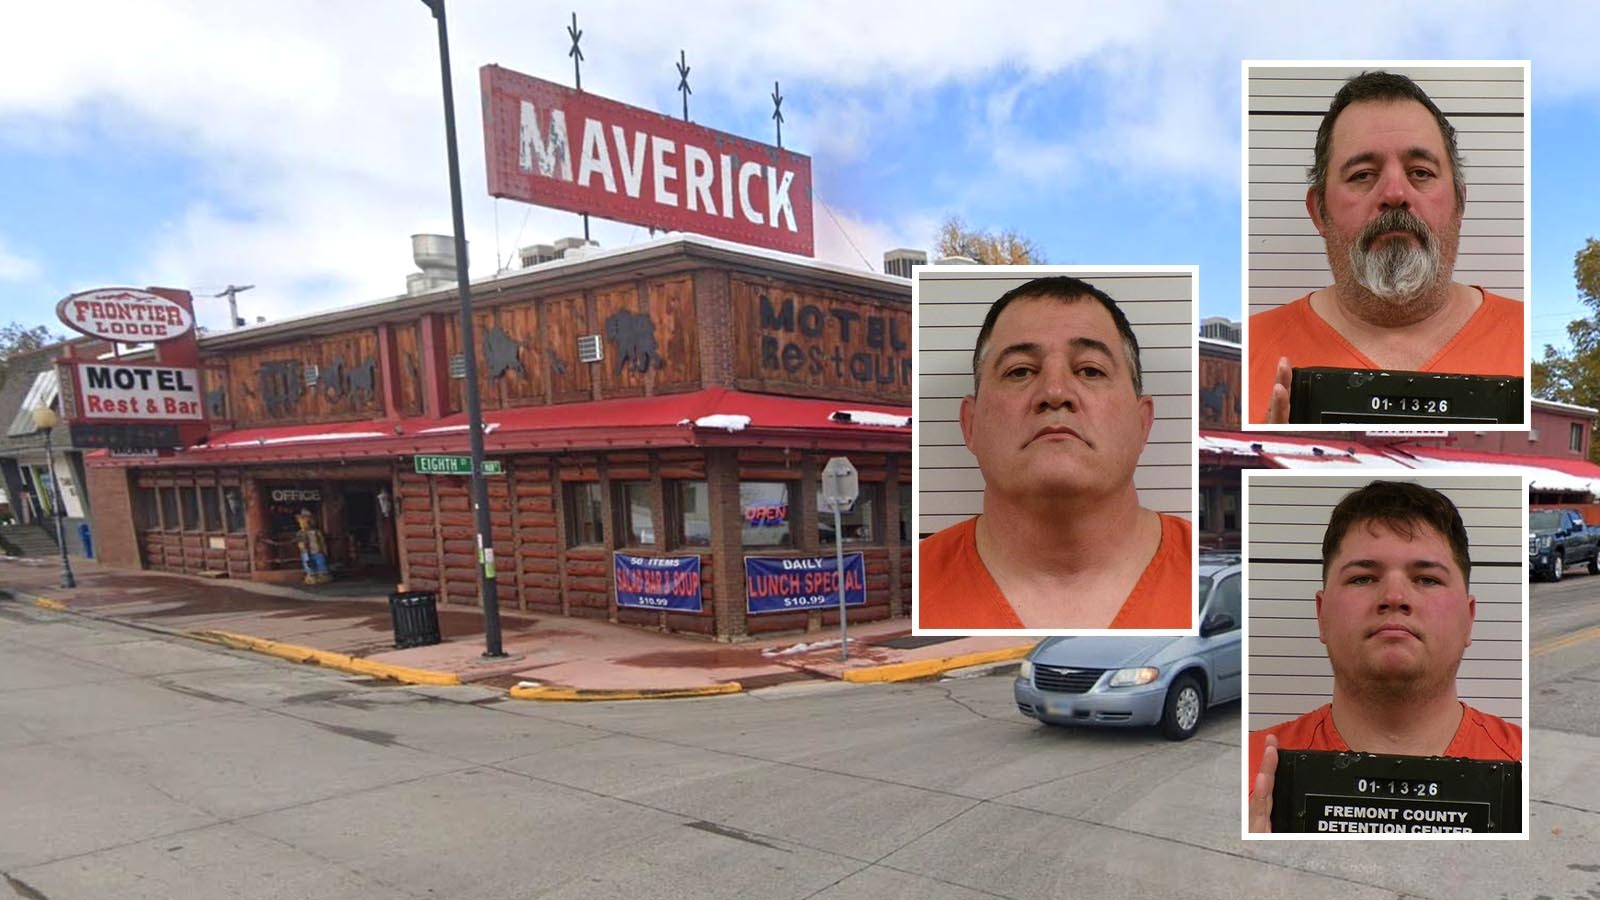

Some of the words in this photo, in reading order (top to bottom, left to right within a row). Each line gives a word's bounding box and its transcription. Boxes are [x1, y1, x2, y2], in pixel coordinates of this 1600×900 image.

[519, 100, 798, 233] MAVERICK
[73, 300, 184, 326] FRONTIER
[95, 321, 168, 336] LODGE
[759, 294, 908, 351] MOTEL
[86, 366, 193, 392] MOTEL
[88, 394, 139, 414] Rest
[146, 397, 158, 413] &
[164, 397, 199, 414] Bar
[420, 457, 458, 471] EIGHTH
[272, 489, 321, 501] OFFICE
[744, 505, 788, 521] OPEN
[648, 559, 680, 567] ITEMS
[782, 558, 823, 570] DAILY
[748, 573, 800, 597] LUNCH
[805, 568, 862, 594] SPECAL
[638, 597, 668, 606] $10.99
[783, 595, 825, 607] $10.99
[1324, 805, 1399, 820] FREMONT
[1402, 809, 1468, 823] COUNTY
[1317, 820, 1407, 833] DETENTION
